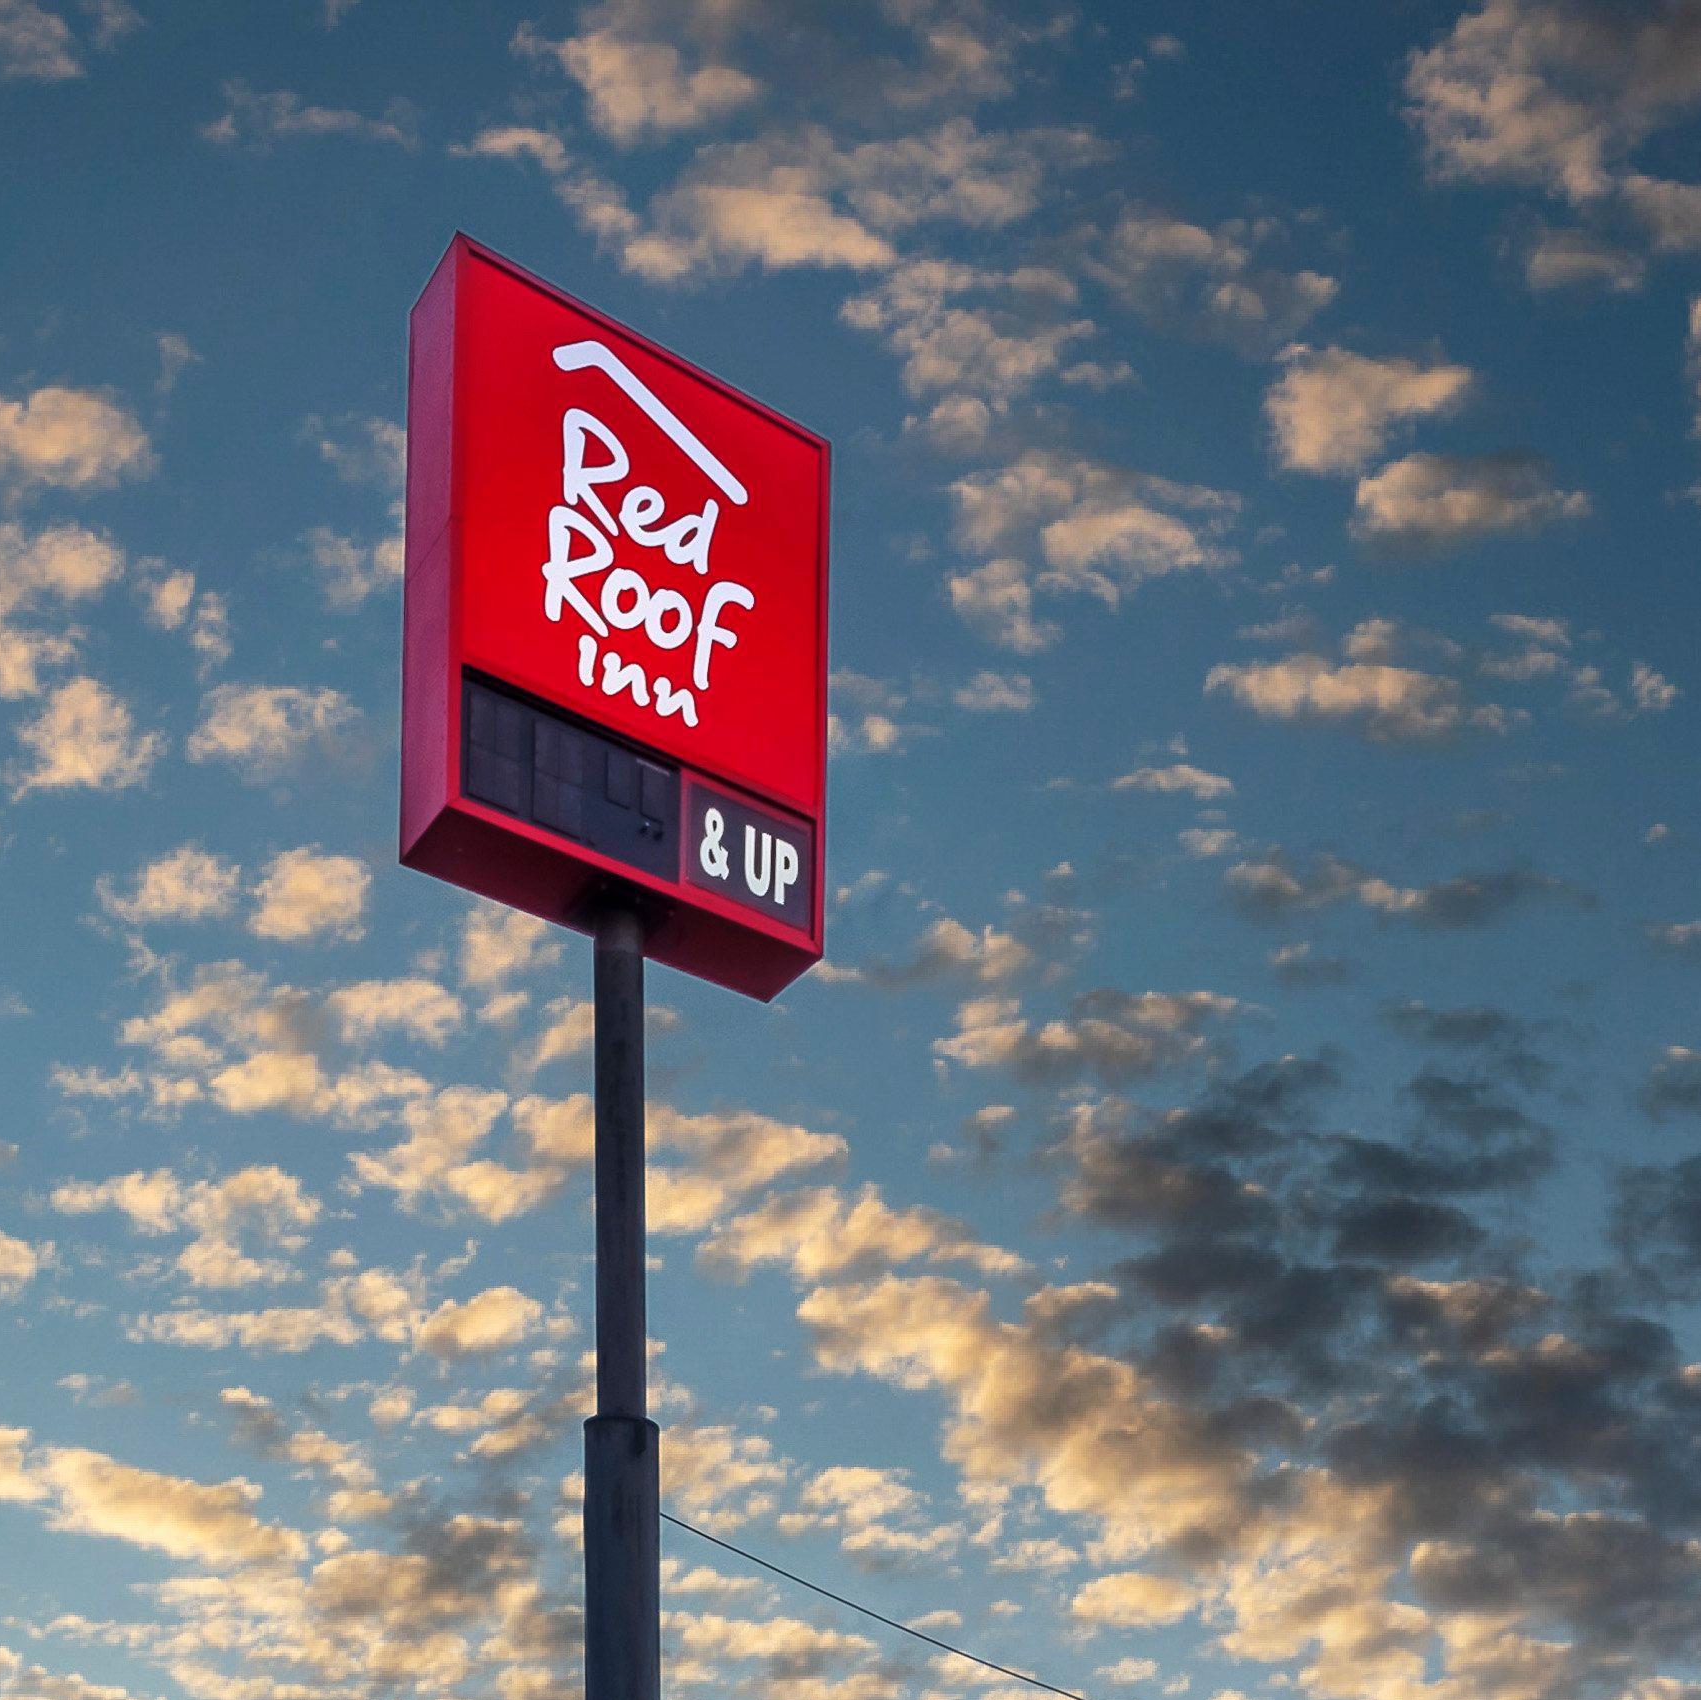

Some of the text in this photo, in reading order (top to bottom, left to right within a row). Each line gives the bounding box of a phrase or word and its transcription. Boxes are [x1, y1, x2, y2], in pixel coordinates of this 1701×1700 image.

[562, 407, 719, 575] Red
[542, 505, 755, 690] Roof
[700, 807, 799, 905] & UP
